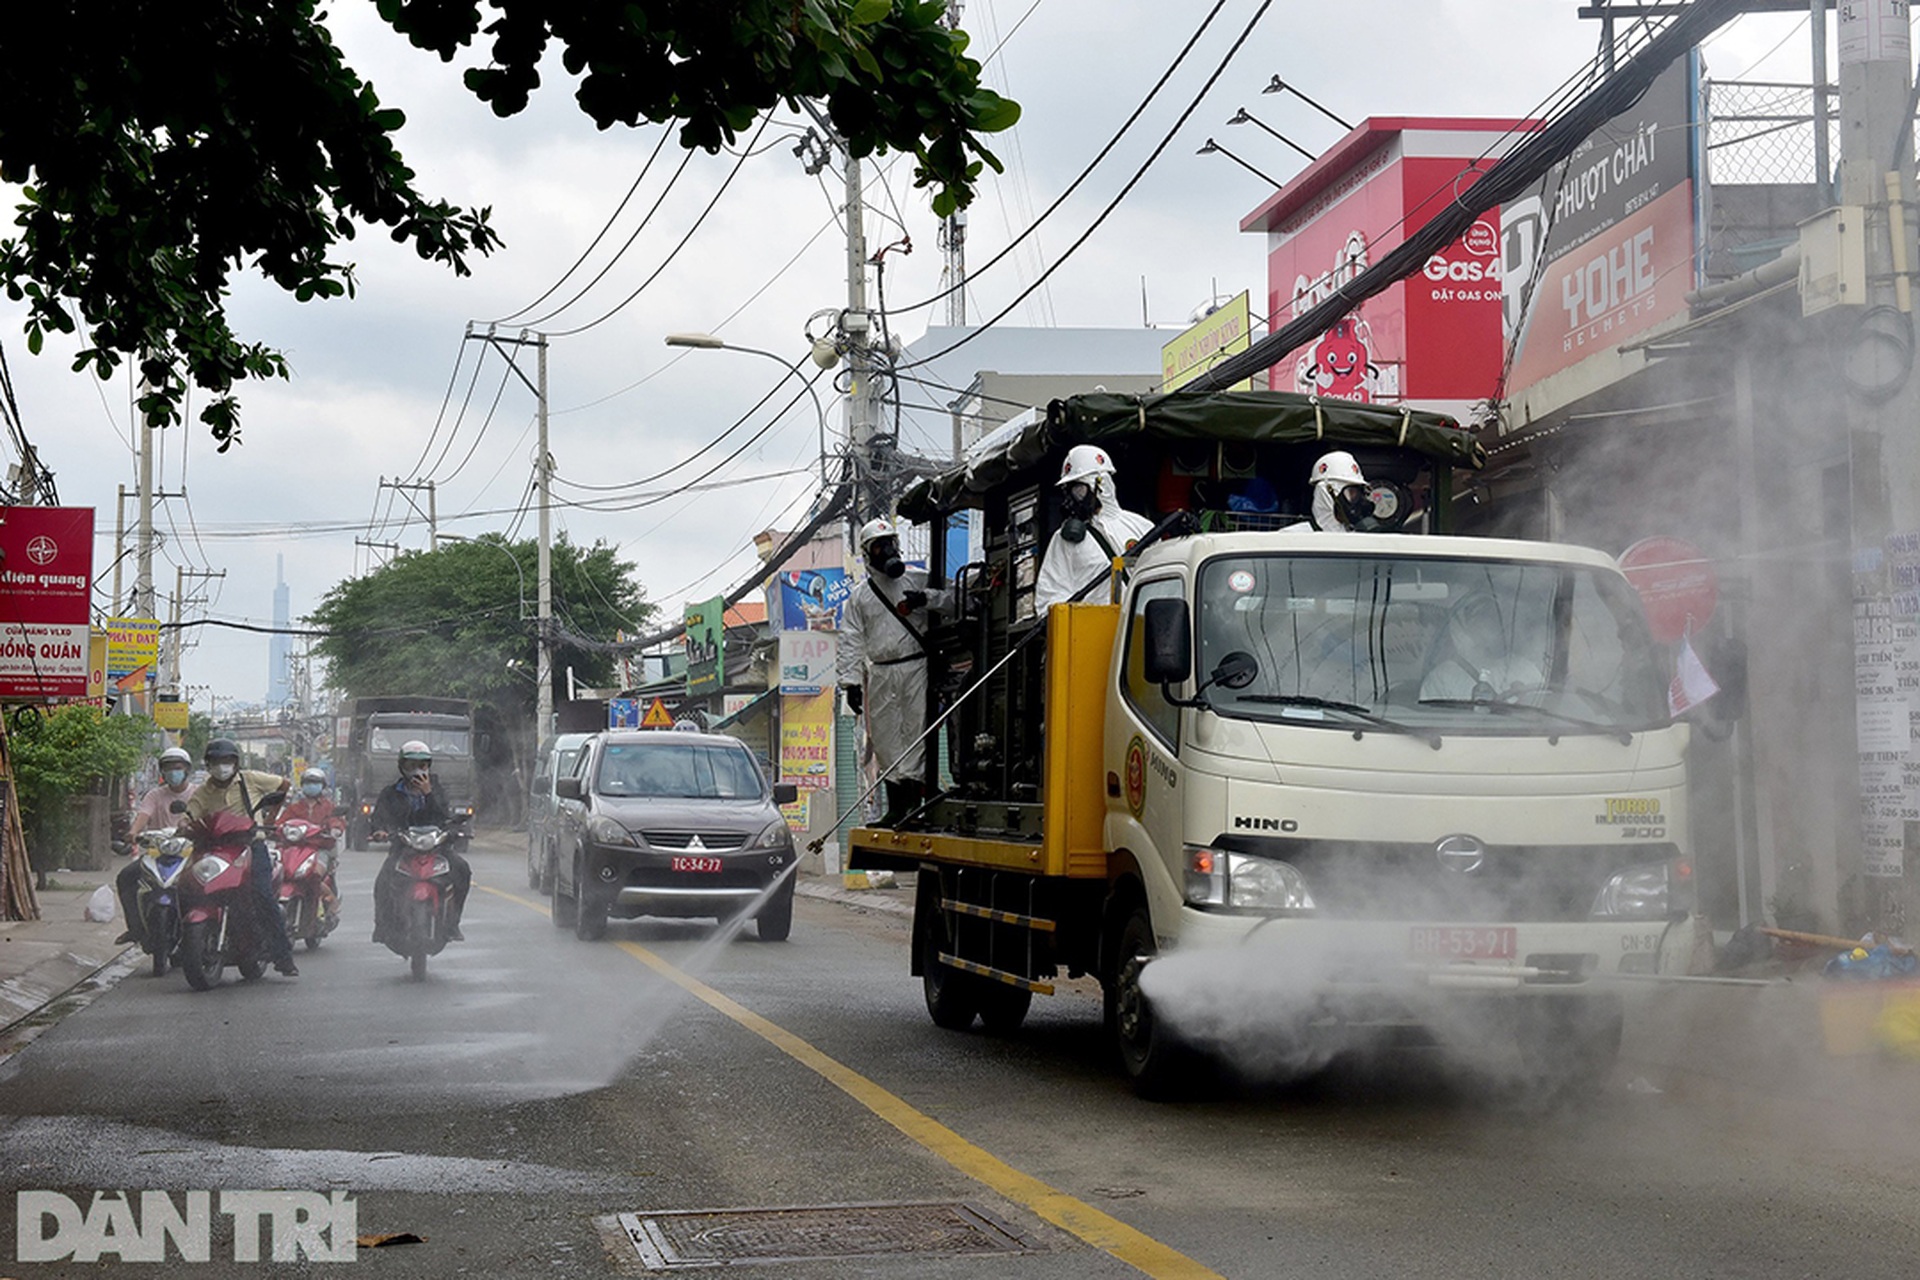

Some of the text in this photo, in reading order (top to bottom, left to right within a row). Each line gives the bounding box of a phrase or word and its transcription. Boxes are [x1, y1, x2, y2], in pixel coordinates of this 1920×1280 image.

[1554, 156, 1609, 224] PHƯỢT
[1612, 121, 1658, 185] CHẤT
[1562, 224, 1655, 329] YOHE
[1457, 289, 1482, 301] GAS
[1563, 294, 1656, 353] HELMETS
[39, 574, 86, 589] quang
[40, 641, 81, 659] QUÂN
[1150, 752, 1177, 788] HINO
[1605, 798, 1661, 822] TURBO
[1234, 816, 1298, 832] HINO
[1621, 827, 1666, 838] 300
